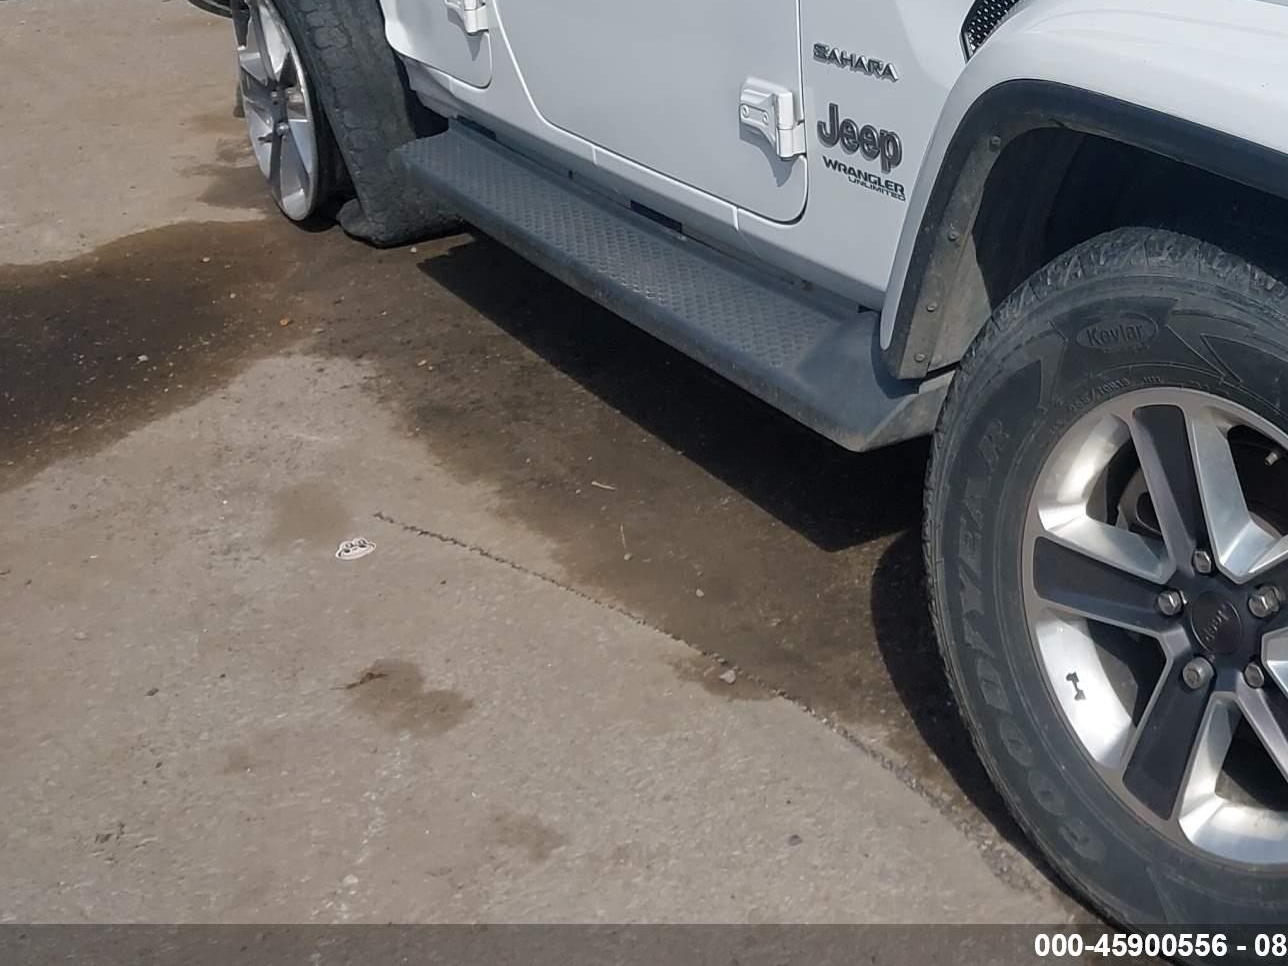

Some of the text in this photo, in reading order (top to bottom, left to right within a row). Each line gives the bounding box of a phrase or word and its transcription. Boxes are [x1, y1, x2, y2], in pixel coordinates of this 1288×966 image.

[812, 41, 900, 83] SAHARA
[816, 102, 904, 175] Jeep
[821, 155, 906, 196] WRANGLER
[847, 175, 907, 202] UNLIMITED
[1086, 321, 1145, 347] Kevlar
[957, 417, 1109, 864] GOODYEAR
